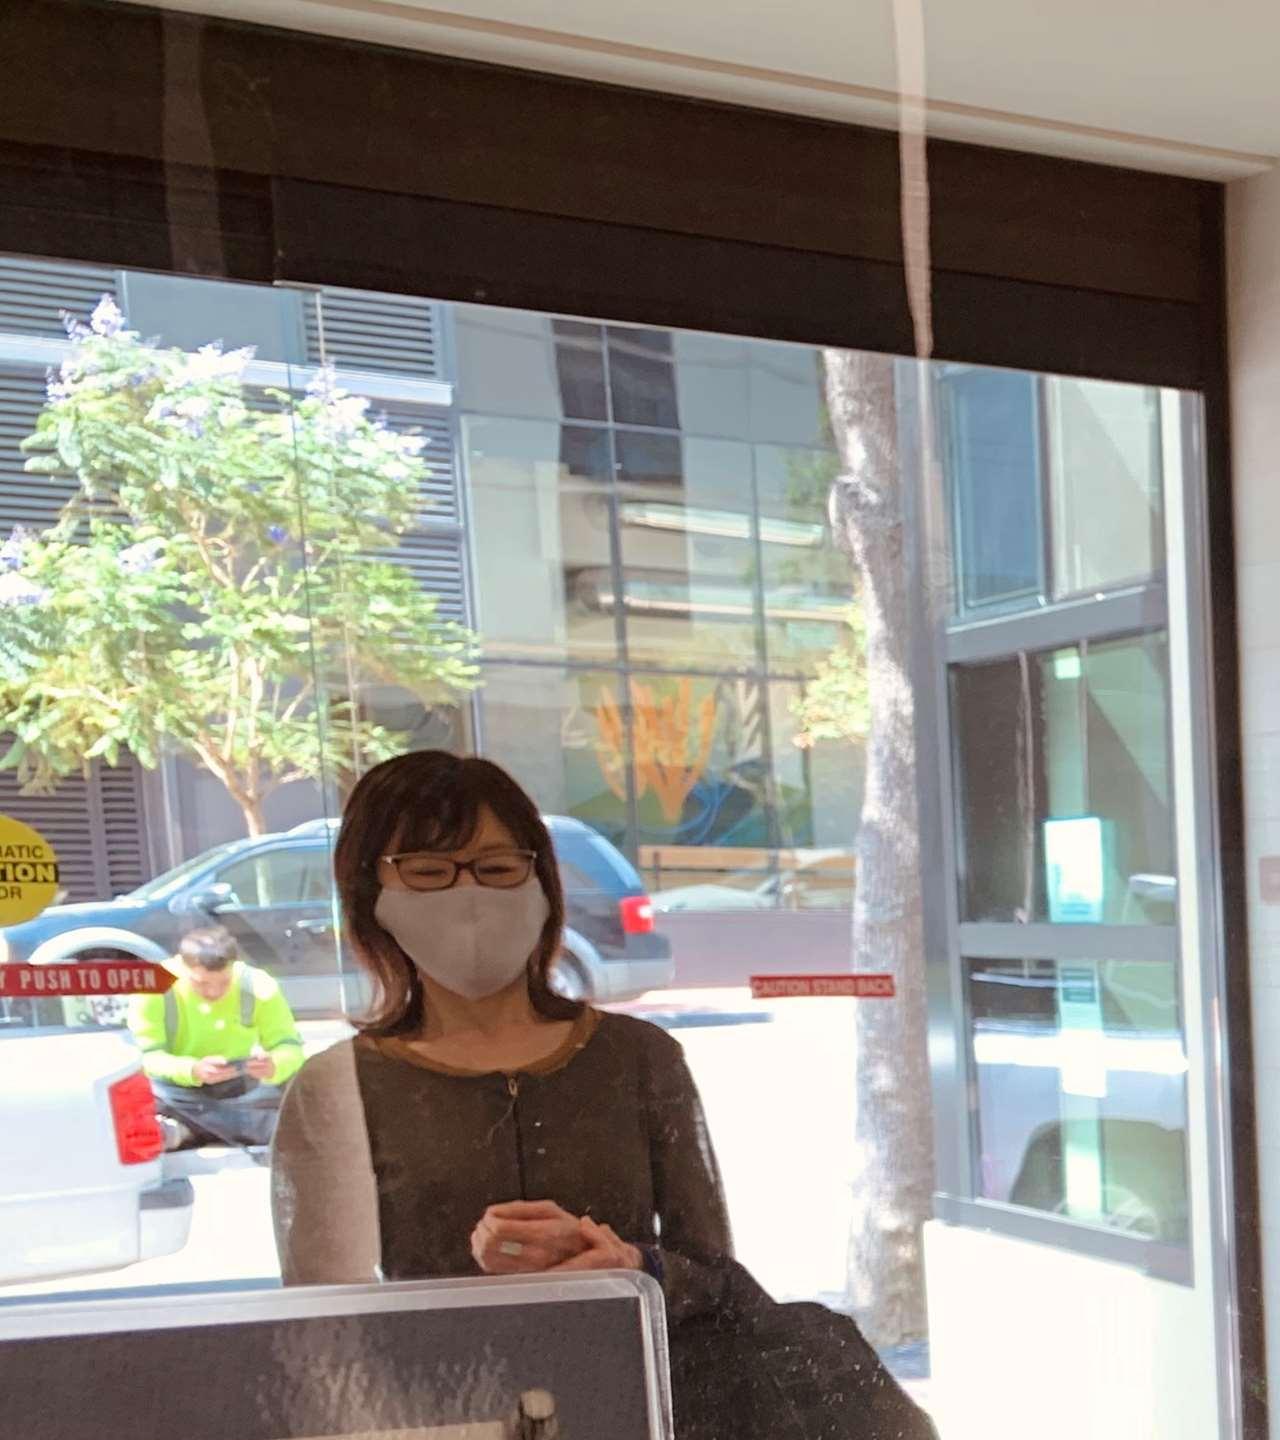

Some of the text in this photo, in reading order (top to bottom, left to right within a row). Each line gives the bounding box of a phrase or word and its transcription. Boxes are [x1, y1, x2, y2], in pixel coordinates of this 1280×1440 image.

[0, 844, 43, 859] ATIC
[20, 969, 72, 991] PUSH
[78, 968, 101, 990] TO
[107, 967, 156, 989] OPEN
